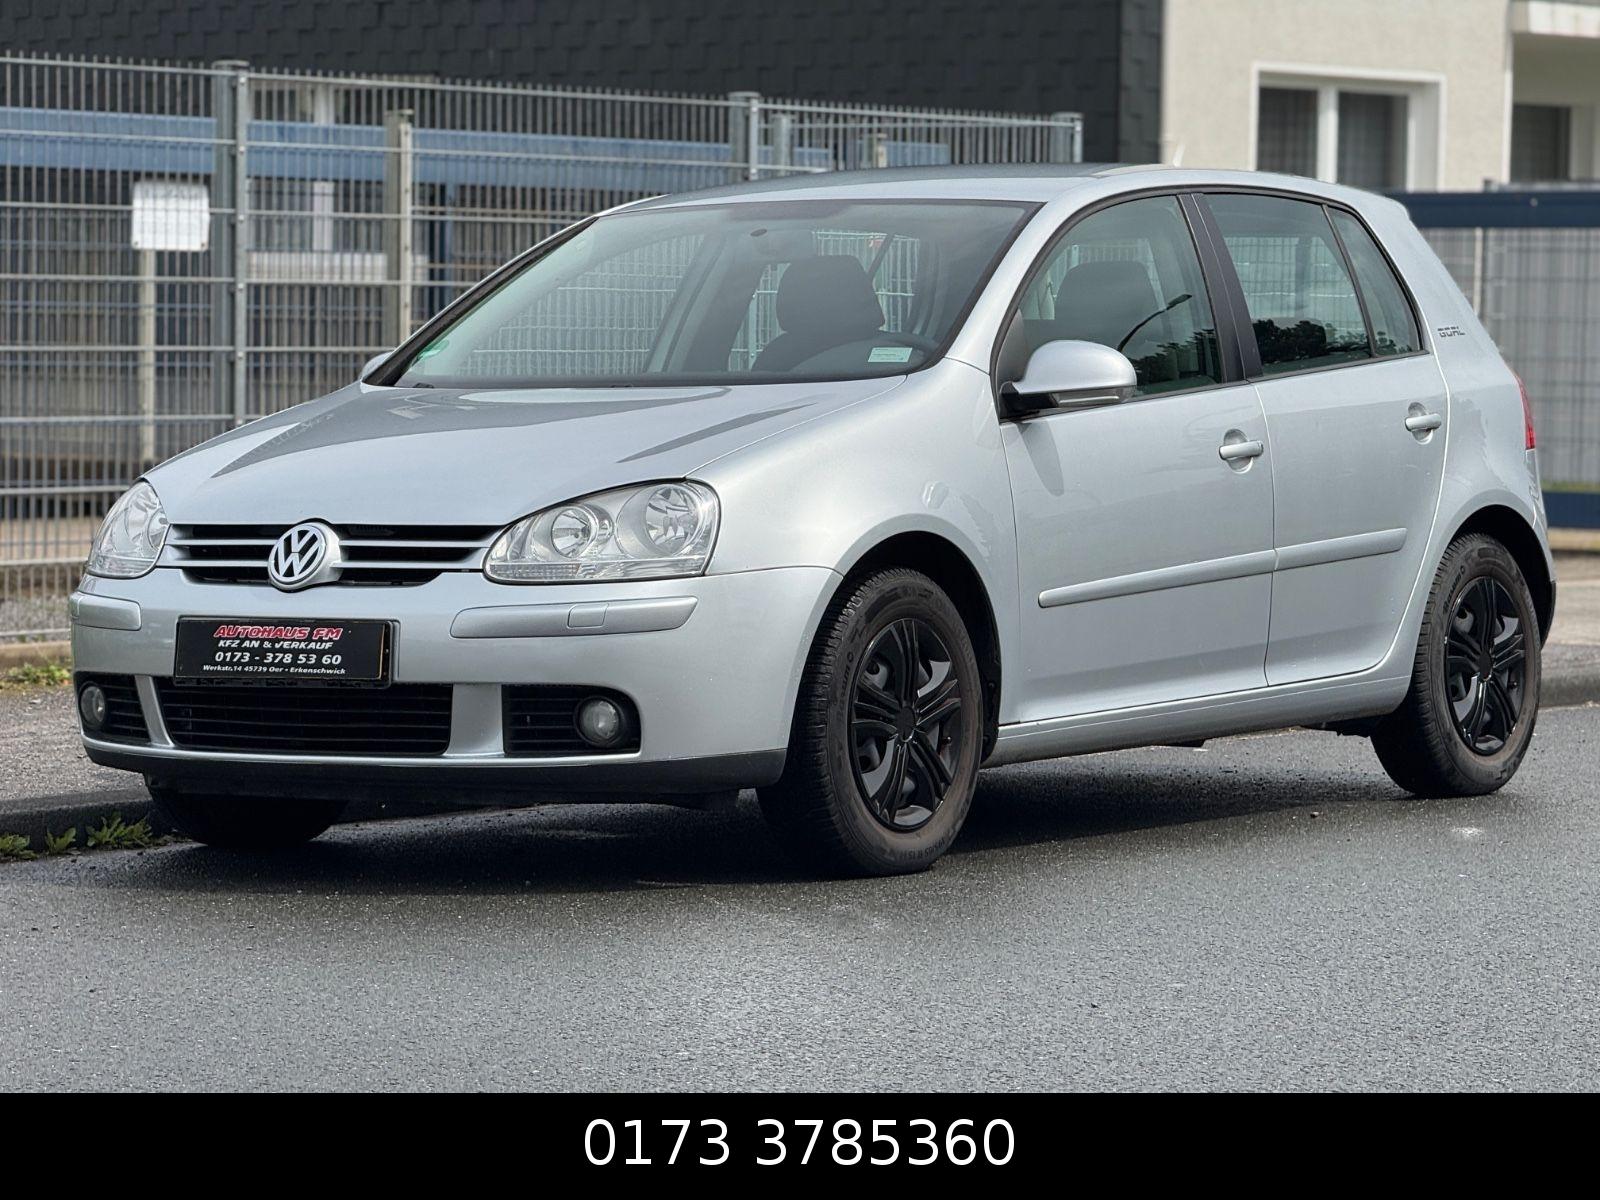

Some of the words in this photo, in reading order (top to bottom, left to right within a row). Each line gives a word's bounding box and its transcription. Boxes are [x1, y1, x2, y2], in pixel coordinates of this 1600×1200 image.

[213, 626, 310, 639] AUTOHAUS
[312, 627, 343, 641] FM
[218, 639, 240, 648] KFZ
[241, 640, 260, 648] AN
[262, 641, 272, 649] &
[274, 641, 333, 650] VERKAUF
[214, 651, 251, 663] 0173
[263, 653, 293, 664] 378
[297, 654, 317, 665] 53
[321, 654, 342, 665] 60
[289, 667, 346, 675] Erkenschwick
